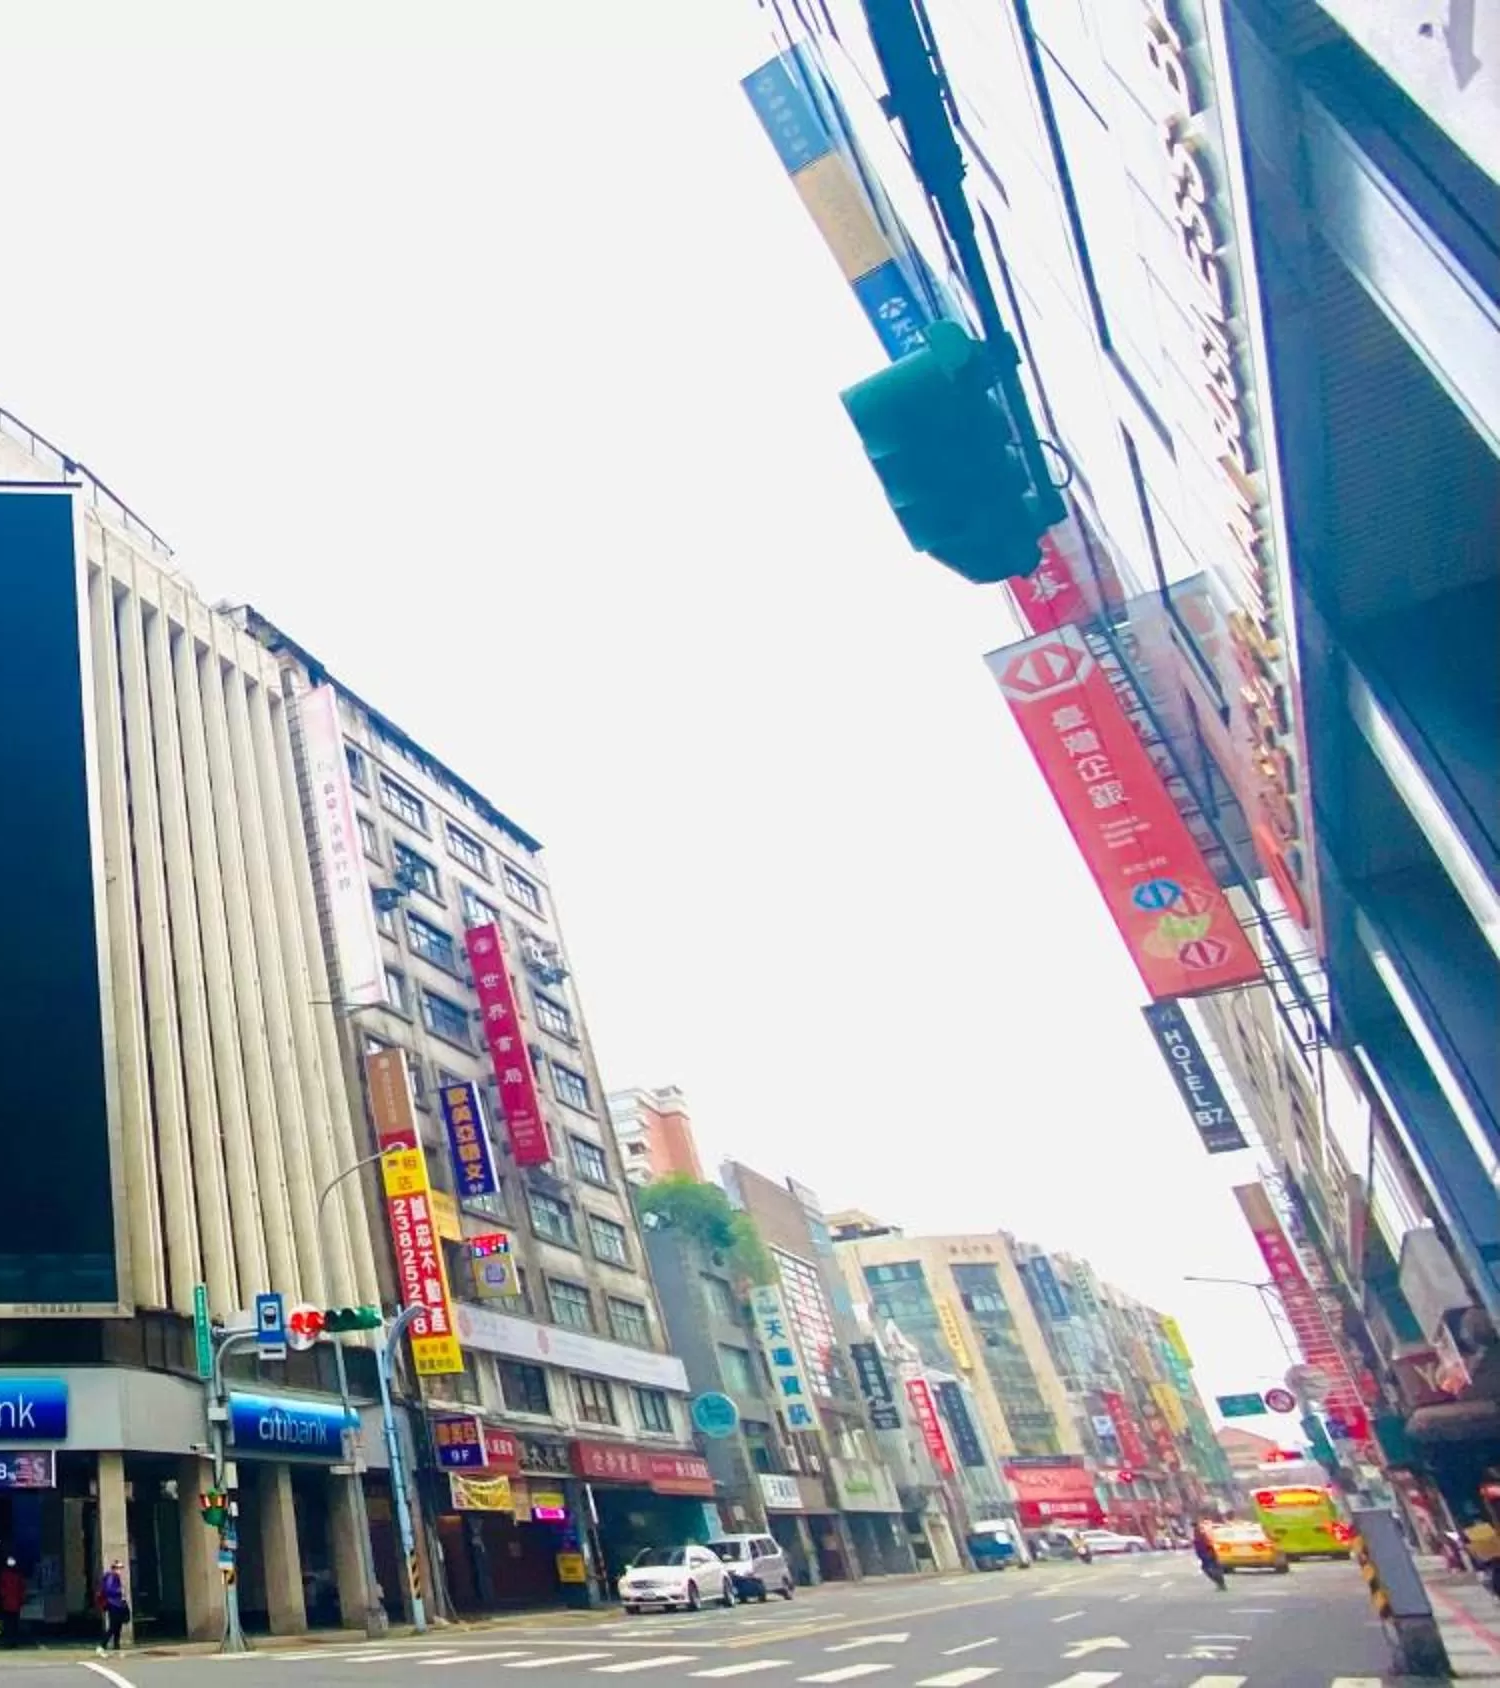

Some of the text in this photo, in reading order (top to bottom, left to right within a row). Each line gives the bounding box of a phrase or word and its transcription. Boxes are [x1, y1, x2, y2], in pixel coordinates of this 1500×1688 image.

[1163, 1029, 1212, 1107] HOTEL
[1195, 1107, 1224, 1126] B7
[258, 1407, 328, 1445] citibank
